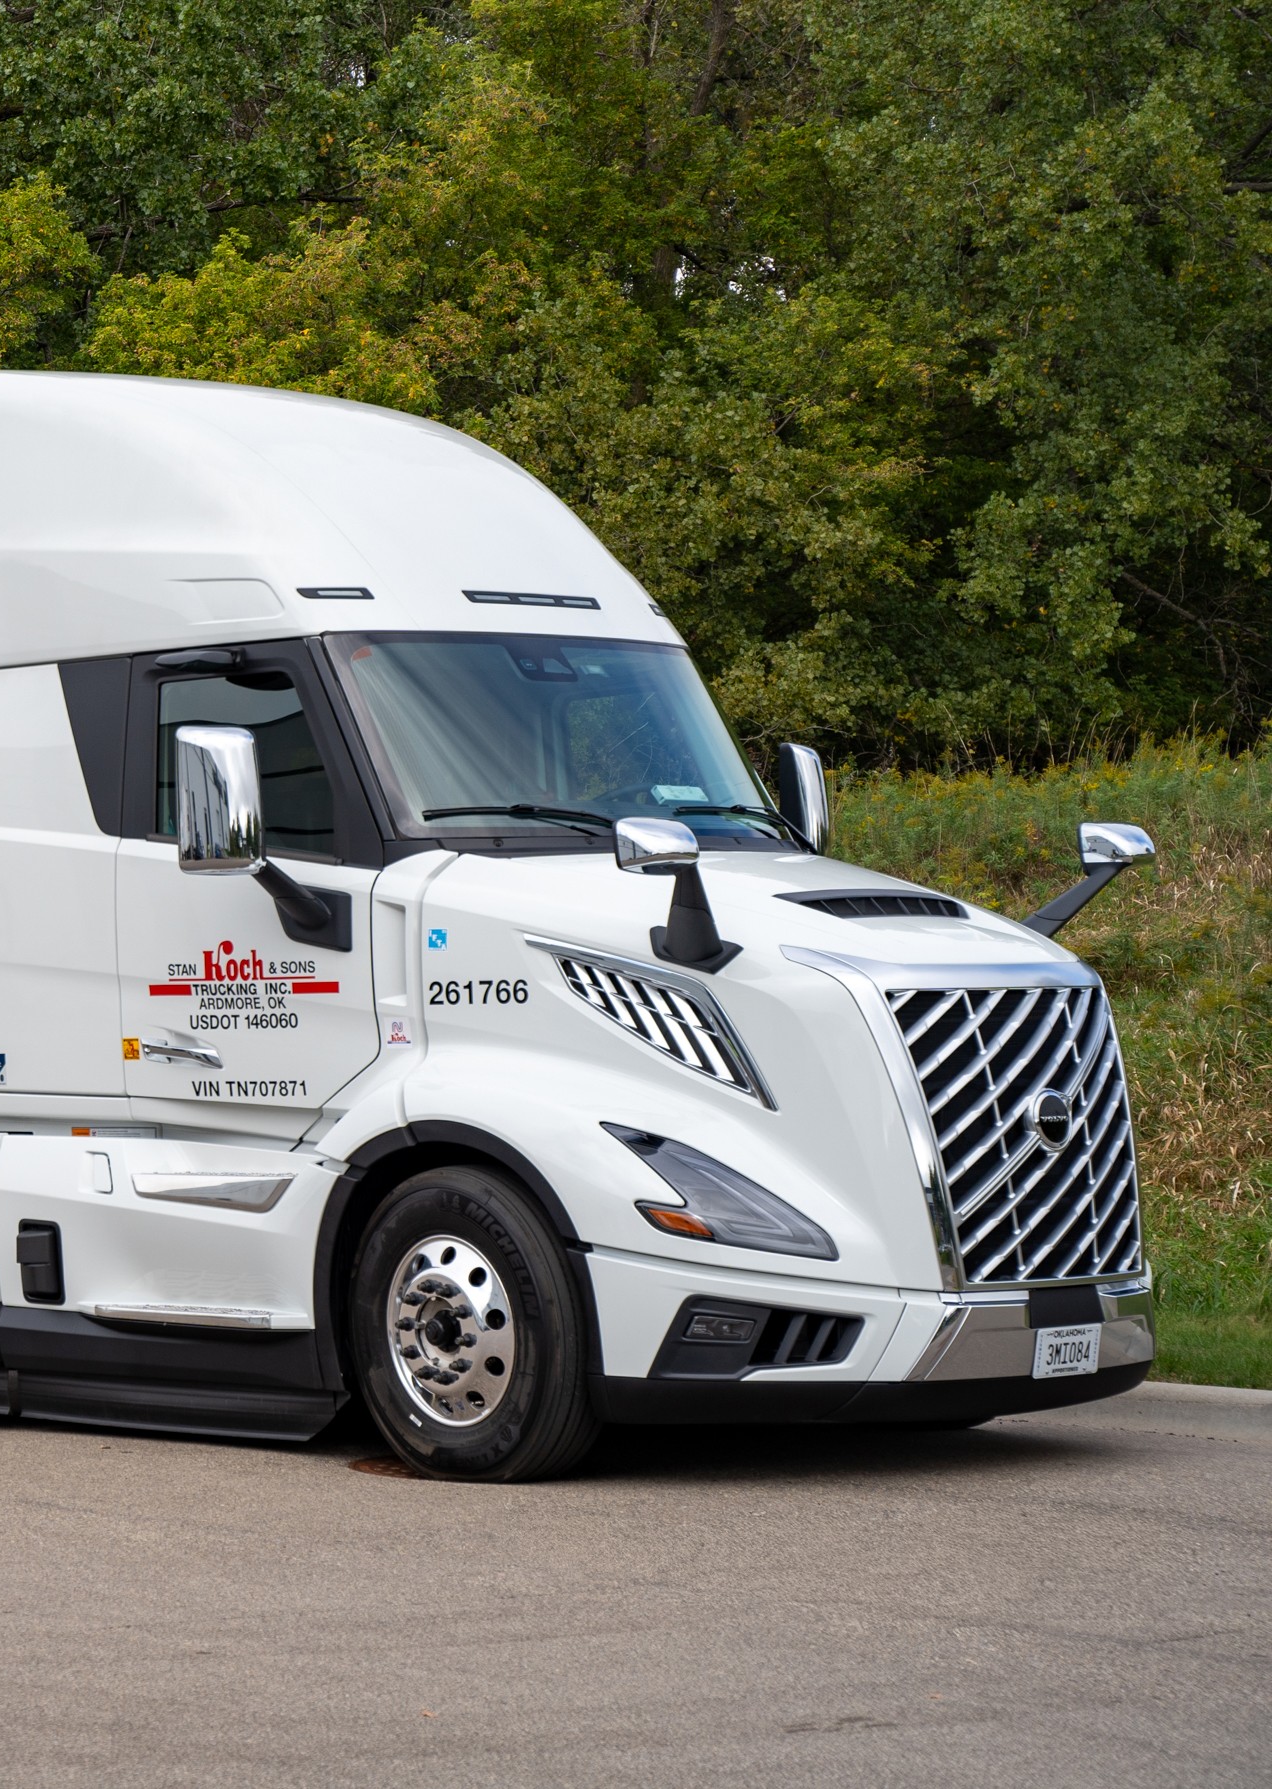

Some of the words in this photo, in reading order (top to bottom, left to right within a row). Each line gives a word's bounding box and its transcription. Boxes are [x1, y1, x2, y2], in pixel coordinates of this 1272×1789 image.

[168, 963, 197, 976] STAN
[202, 940, 264, 982] Koch
[269, 962, 278, 975] &
[280, 960, 316, 974] SONS
[192, 983, 258, 996] TRUCKING
[265, 982, 292, 995] INC.
[428, 979, 529, 1006] 261766
[199, 997, 265, 1011] ARDMORE,
[267, 996, 287, 1009] OK
[189, 1014, 240, 1030] USDOT
[244, 1013, 299, 1029] 146060
[191, 1081, 220, 1097] VIN
[225, 1080, 308, 1097] TN707871
[464, 1201, 542, 1320] MICHELIN
[1053, 1328, 1087, 1339] OKLAHOMA
